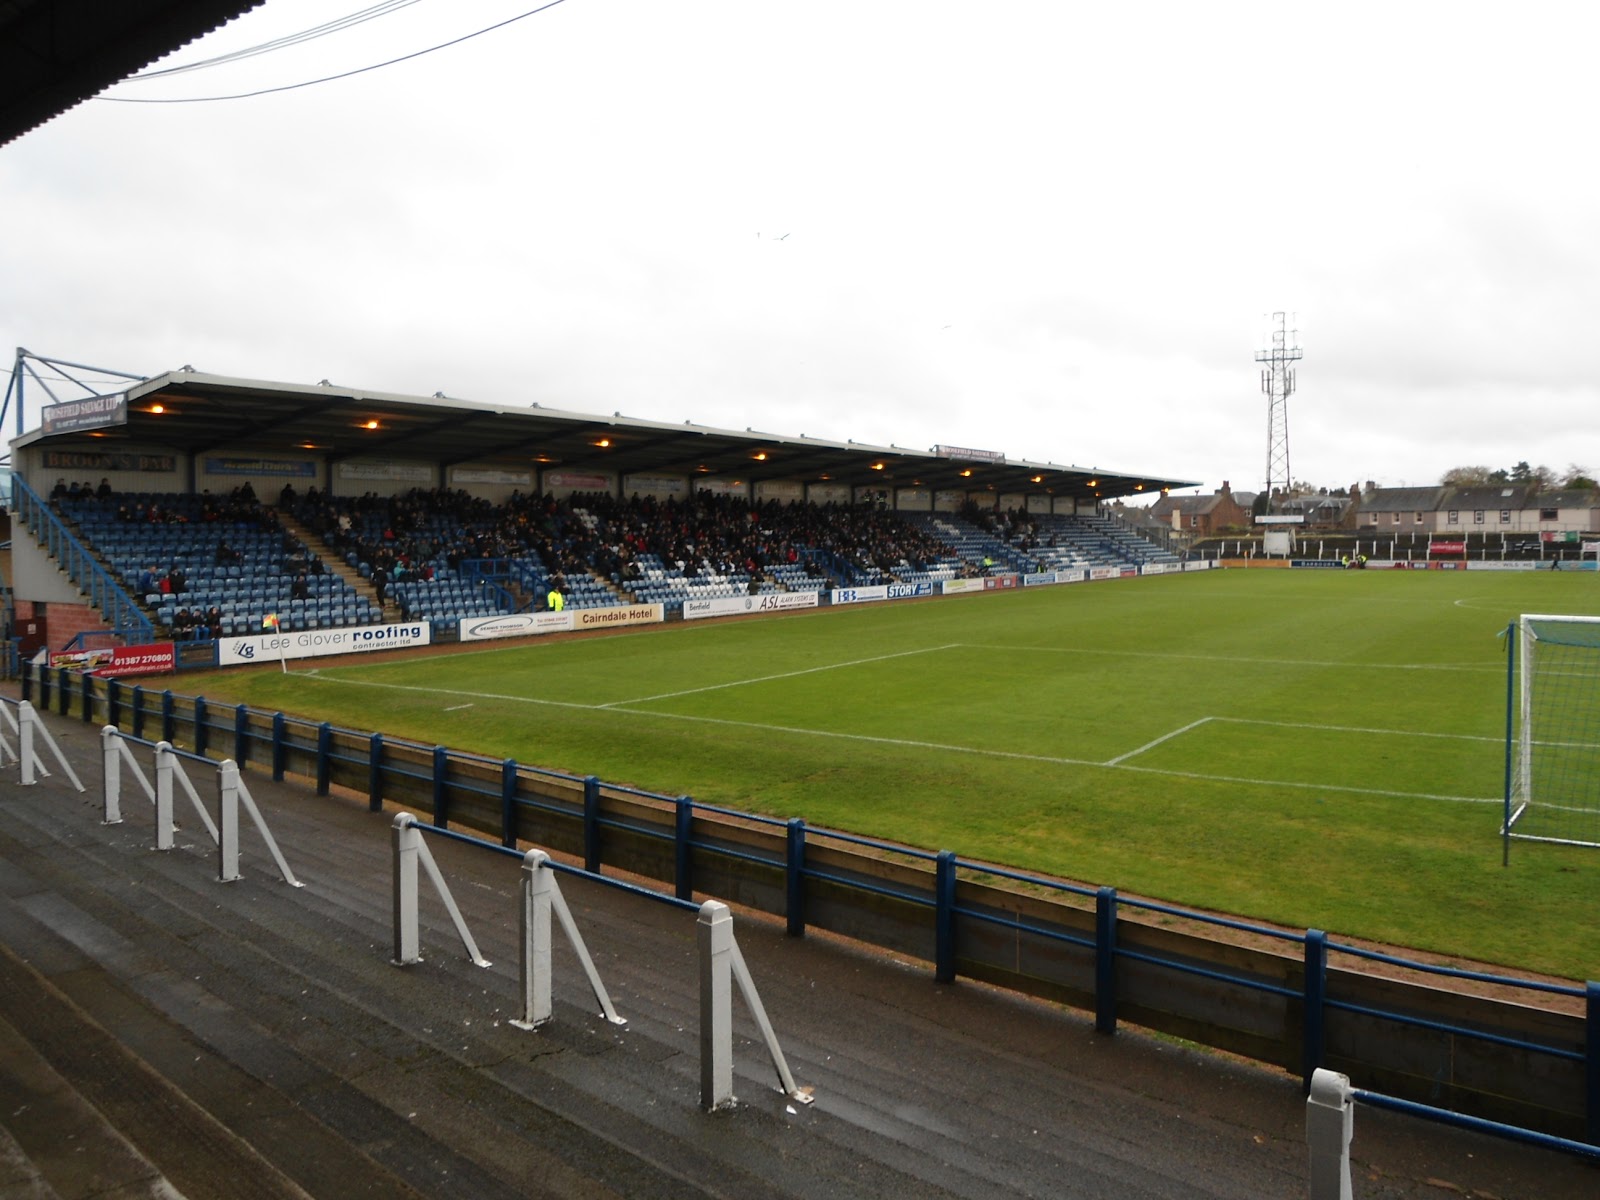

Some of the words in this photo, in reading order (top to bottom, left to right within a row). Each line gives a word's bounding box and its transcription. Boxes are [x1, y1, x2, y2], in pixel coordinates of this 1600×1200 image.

[80, 399, 104, 415] SALVAGE
[105, 398, 117, 411] LTD
[139, 455, 171, 470] BAR
[889, 584, 917, 597] STORY
[689, 601, 711, 611] Benfield
[760, 596, 779, 610] ASL
[583, 611, 627, 623] Cairndale
[629, 609, 652, 619] Hotel
[261, 638, 290, 651] Lee
[297, 632, 347, 648] Glover
[353, 626, 421, 642] roofing
[353, 640, 397, 650] contractor
[399, 638, 411, 646] ltd
[115, 656, 141, 666] 01387
[142, 654, 172, 665] 270800
[100, 663, 172, 676] www.thefoodtrain.co.uk
